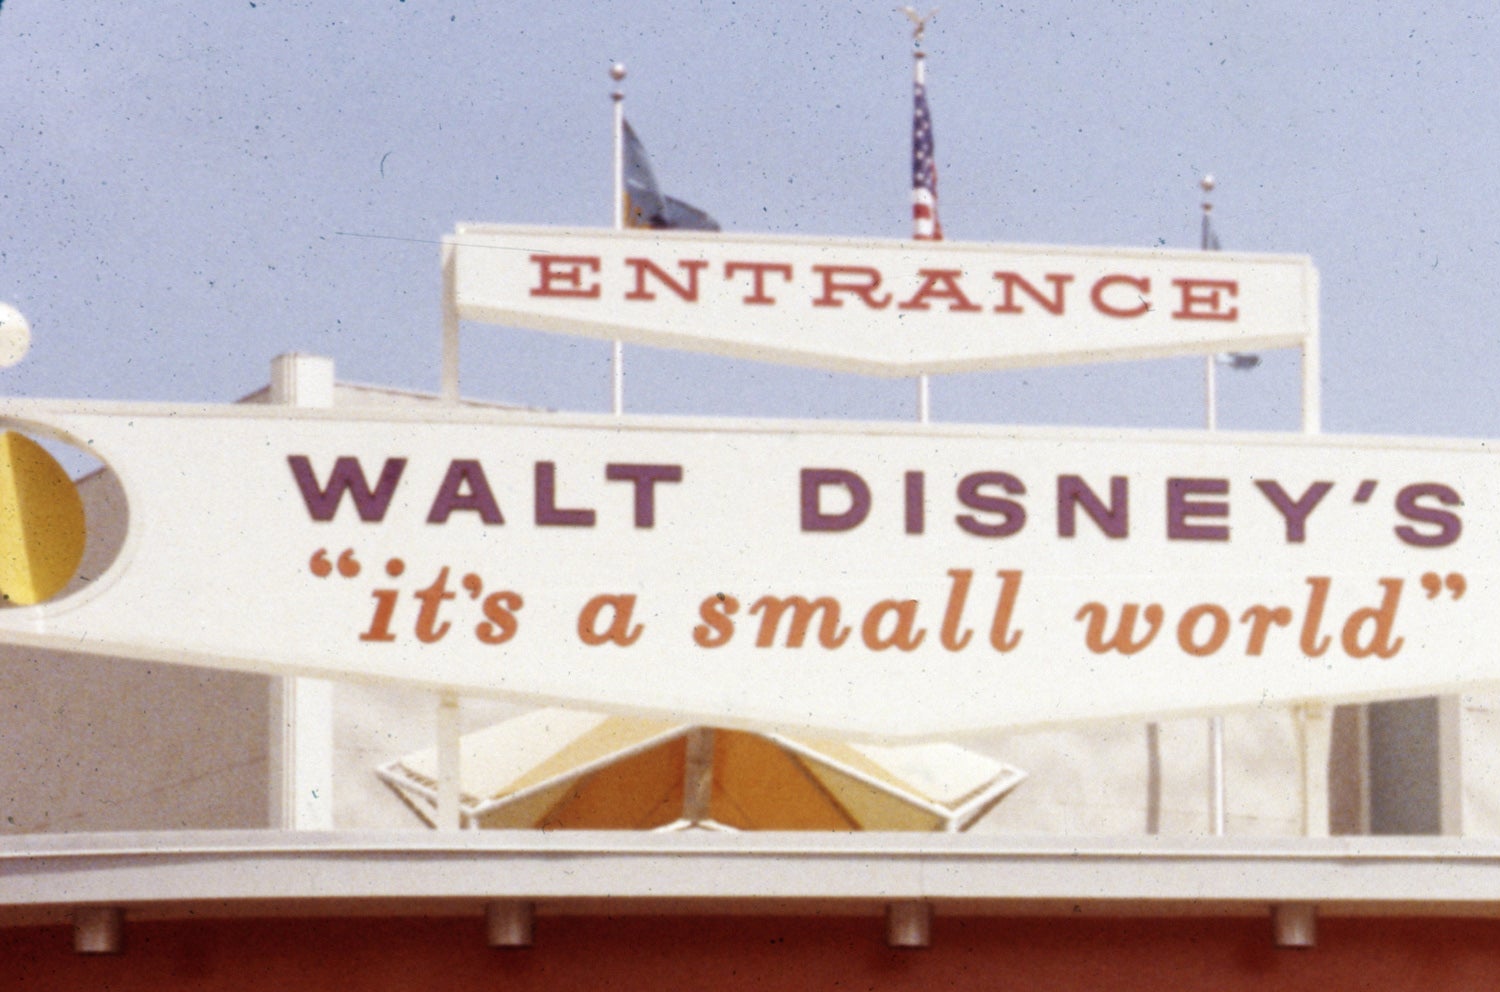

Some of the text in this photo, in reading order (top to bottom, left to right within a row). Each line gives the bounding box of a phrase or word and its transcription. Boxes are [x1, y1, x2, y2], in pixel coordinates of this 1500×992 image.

[529, 253, 1240, 322] ENTRANCE
[286, 454, 1463, 549] WALT DISNEY'S
[308, 547, 1468, 660] "it's a small world"
